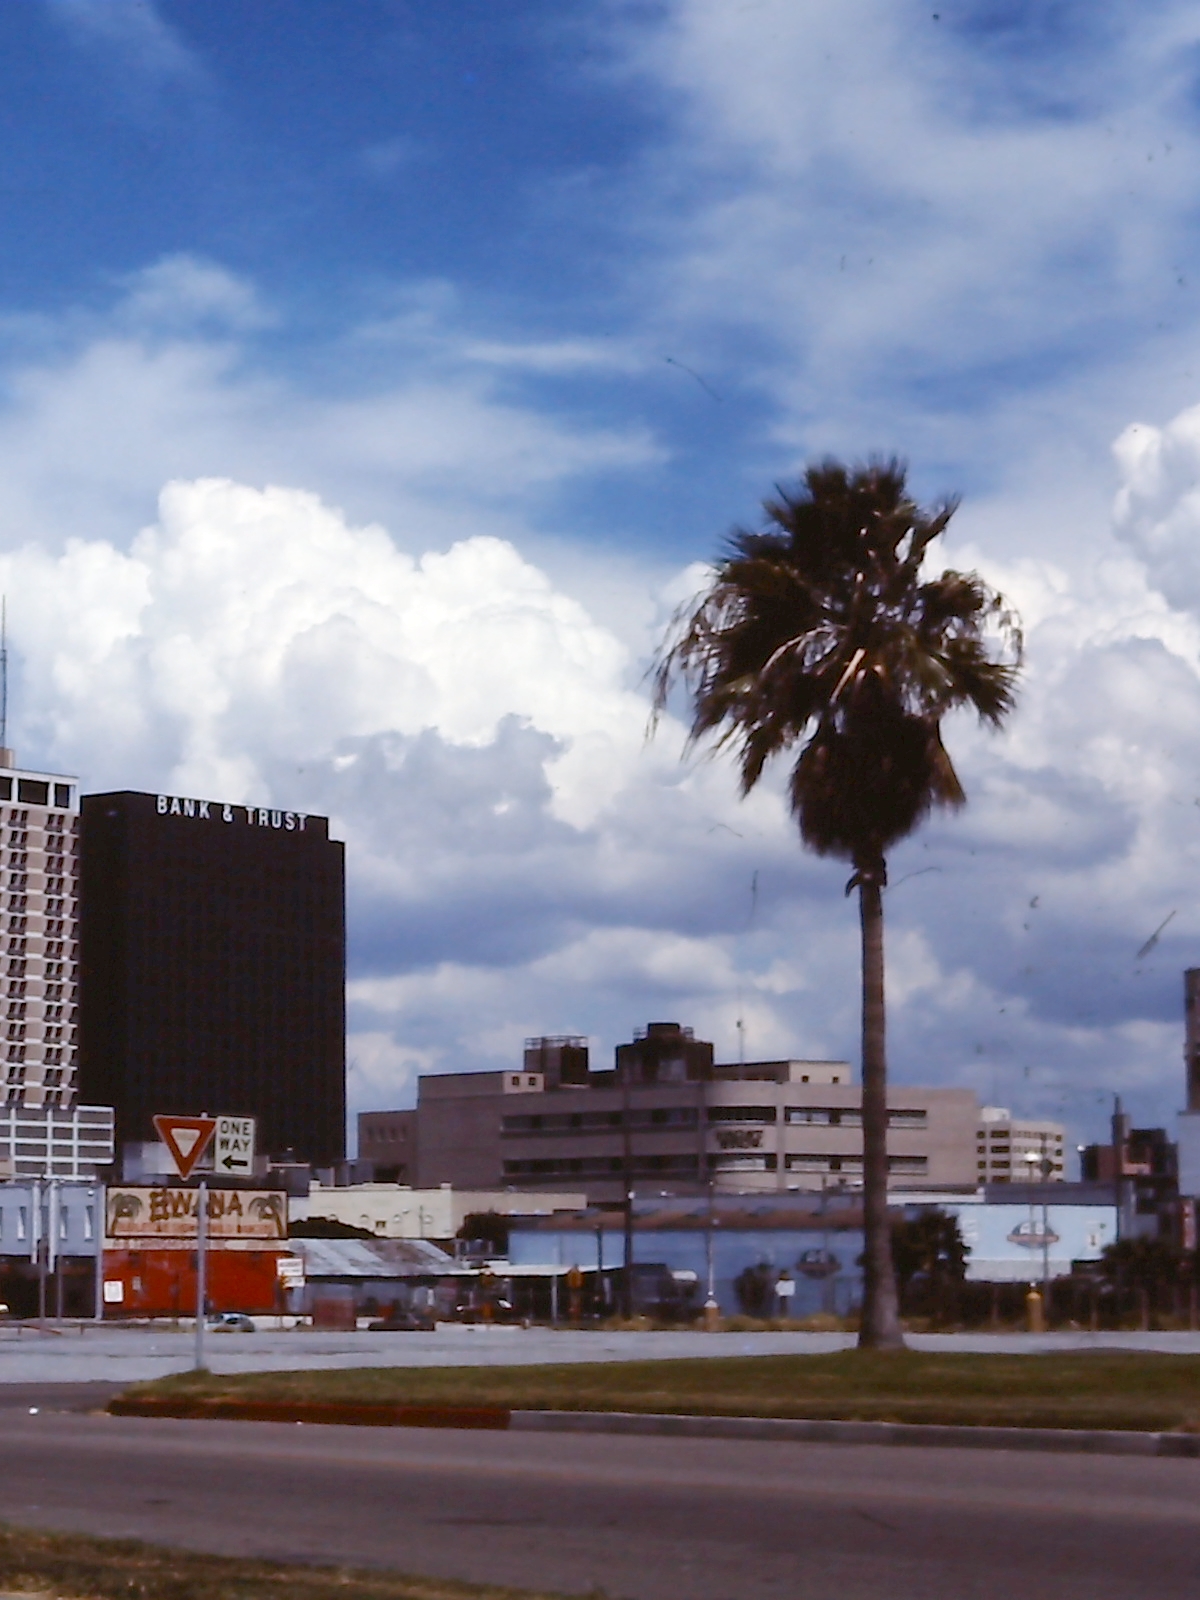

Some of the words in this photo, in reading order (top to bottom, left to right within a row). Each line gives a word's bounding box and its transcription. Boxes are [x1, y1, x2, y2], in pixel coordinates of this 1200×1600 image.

[156, 795, 211, 820] BANK
[222, 804, 234, 823] &
[245, 806, 308, 832] TRUST
[220, 1119, 251, 1136] ONE
[218, 1137, 251, 1152] WAY
